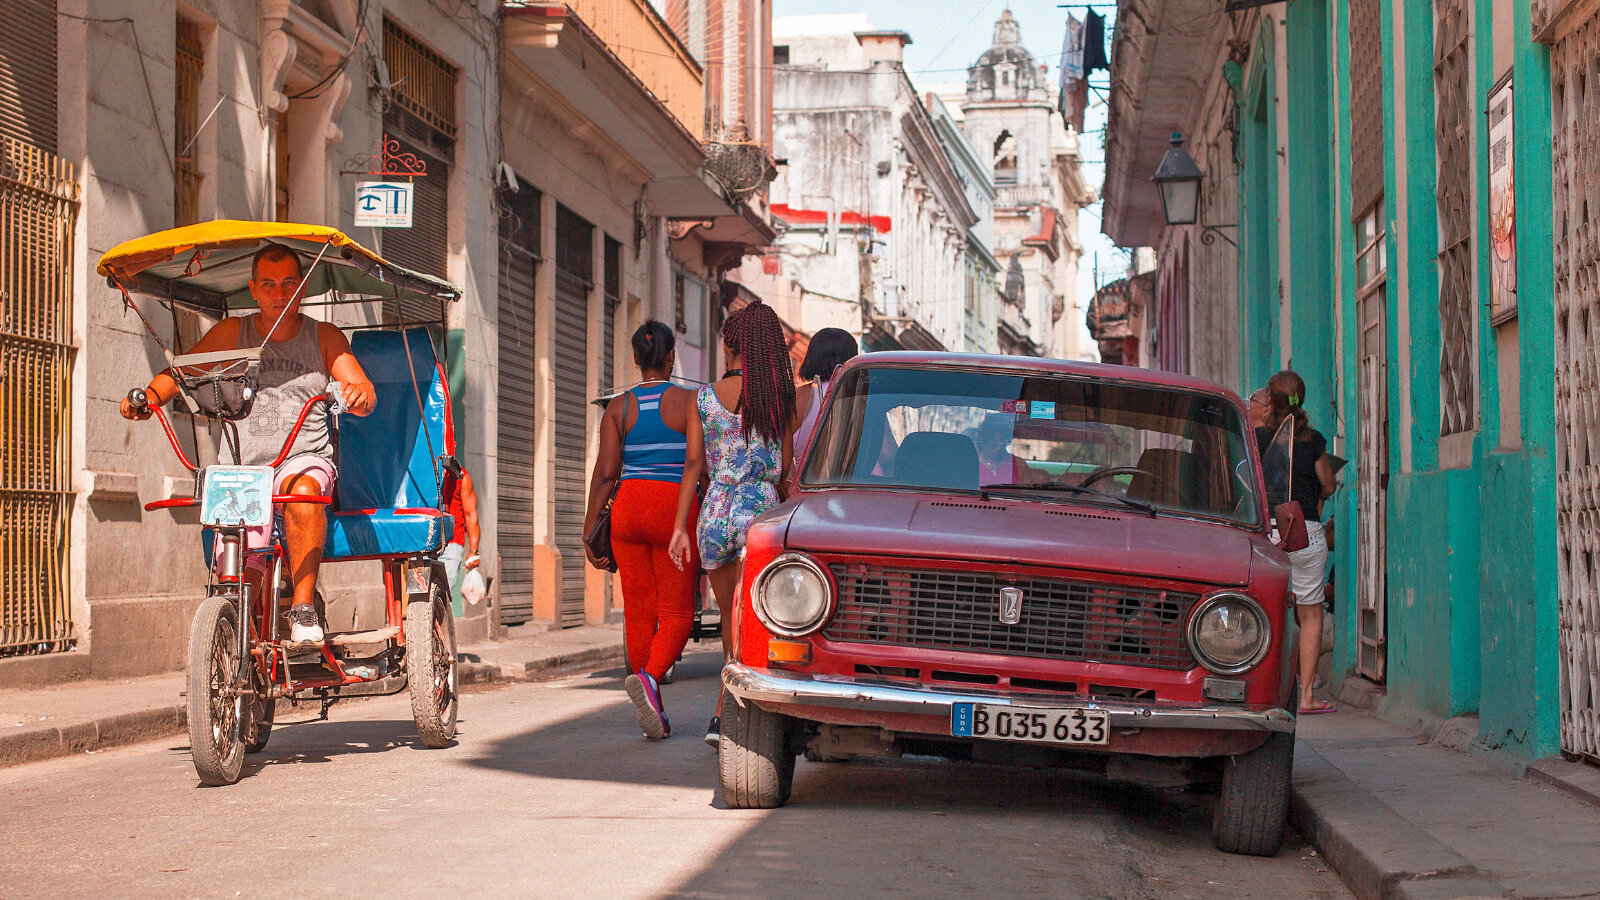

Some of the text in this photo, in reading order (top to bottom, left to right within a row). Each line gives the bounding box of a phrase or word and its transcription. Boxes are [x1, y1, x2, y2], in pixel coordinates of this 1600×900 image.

[973, 710, 1105, 742] B 035 633
